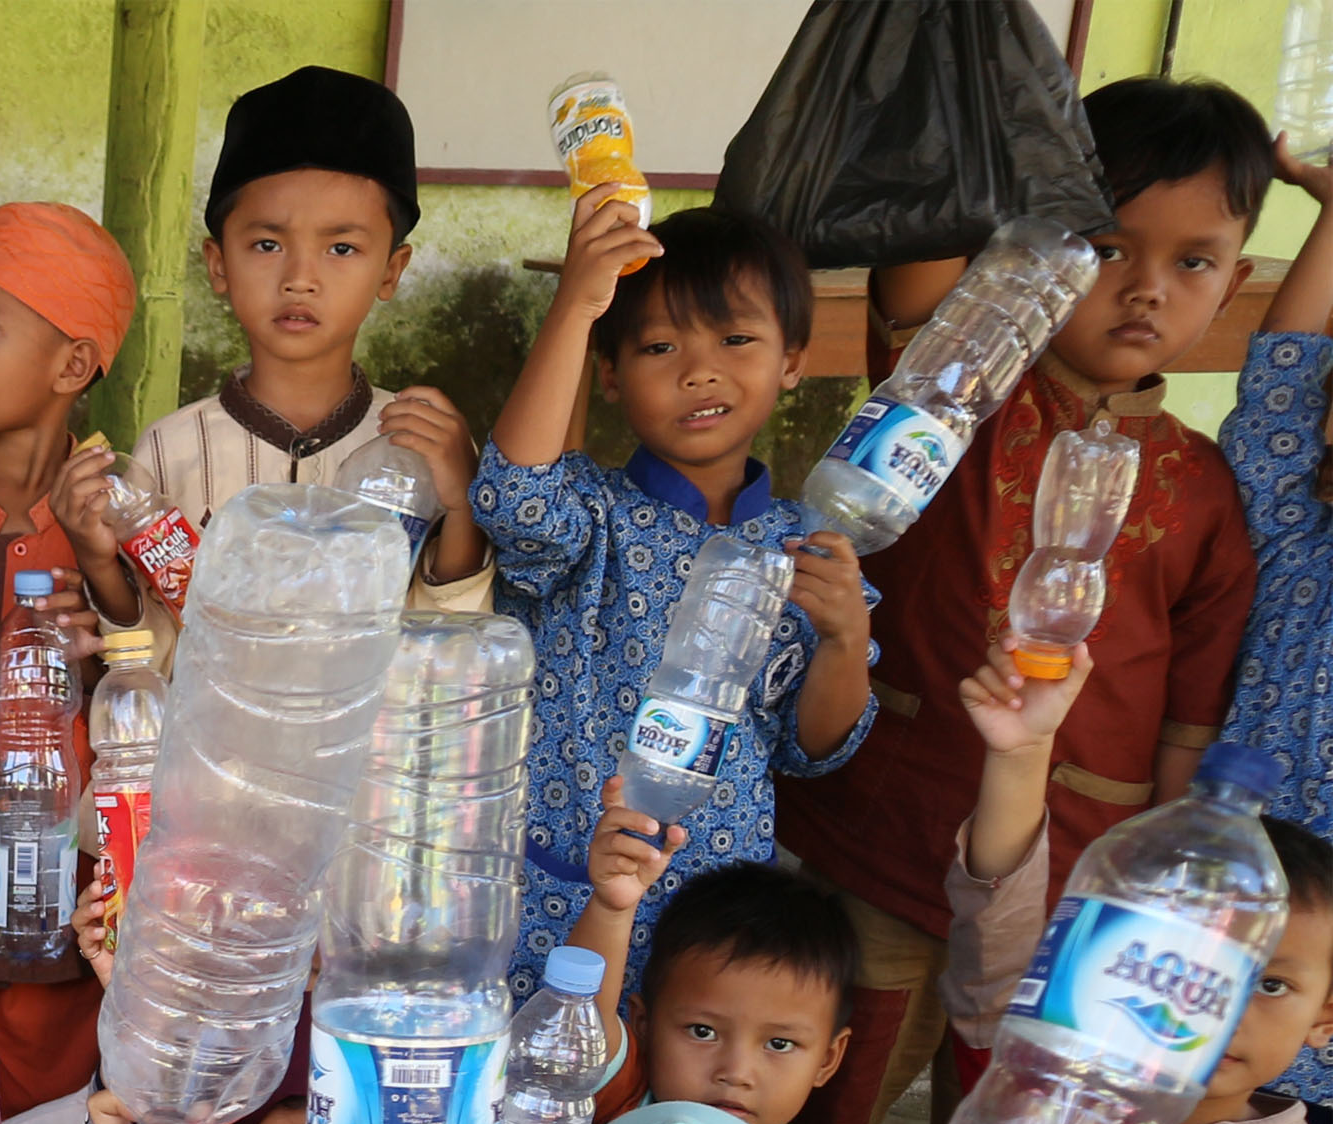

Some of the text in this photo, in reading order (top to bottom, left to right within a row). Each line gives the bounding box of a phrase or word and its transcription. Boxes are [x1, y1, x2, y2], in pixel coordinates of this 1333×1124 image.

[557, 117, 623, 156] Floridina
[140, 525, 189, 574] pucuk
[158, 540, 191, 568] HARUM
[636, 724, 691, 757] AQUA
[1103, 939, 1233, 1019] AQUA
